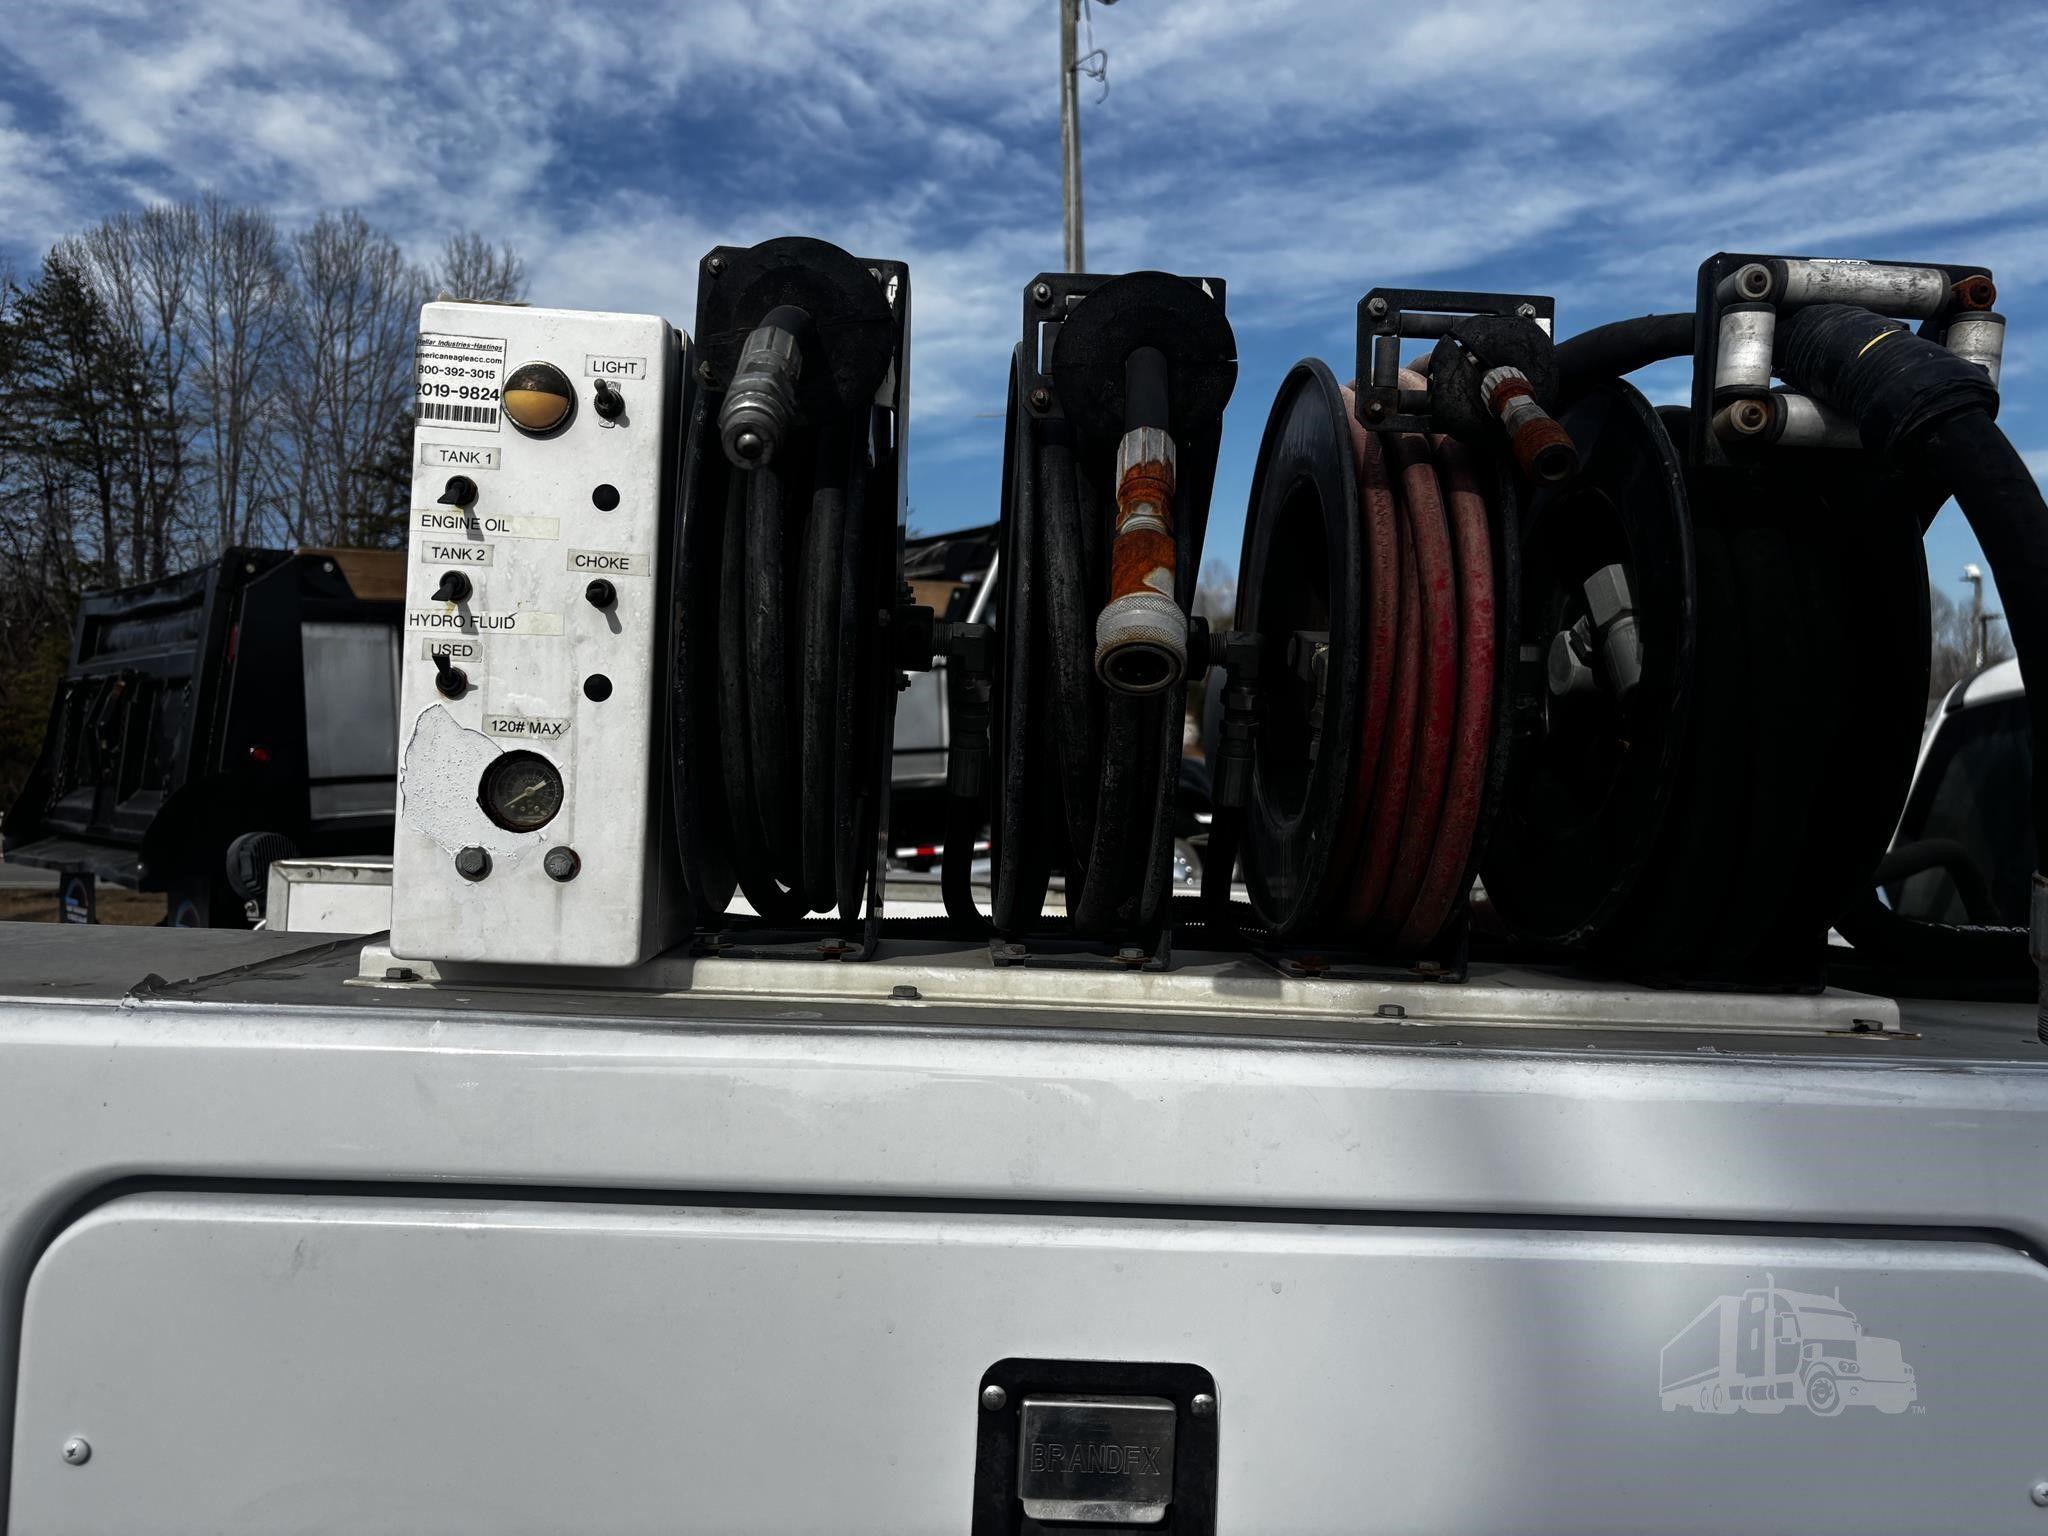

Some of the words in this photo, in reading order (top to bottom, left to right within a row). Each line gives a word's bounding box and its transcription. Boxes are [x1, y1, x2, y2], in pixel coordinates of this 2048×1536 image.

[418, 365, 496, 379] 800-392-3015
[593, 360, 638, 374] LIGHT
[416, 383, 500, 401] 2019-9824
[440, 450, 481, 464] TANK
[485, 453, 492, 464] 1
[421, 515, 480, 530] ENGINE
[485, 518, 510, 532] OIL
[432, 546, 472, 561] TANK
[476, 549, 485, 561] 2
[575, 555, 630, 570] CHOKE
[409, 614, 466, 628] HYDRO
[470, 616, 516, 629] FLUID
[431, 643, 473, 657] USED
[491, 720, 525, 733] 120#
[529, 721, 562, 735] MAX
[1030, 1443, 1161, 1475] BRANDFX
